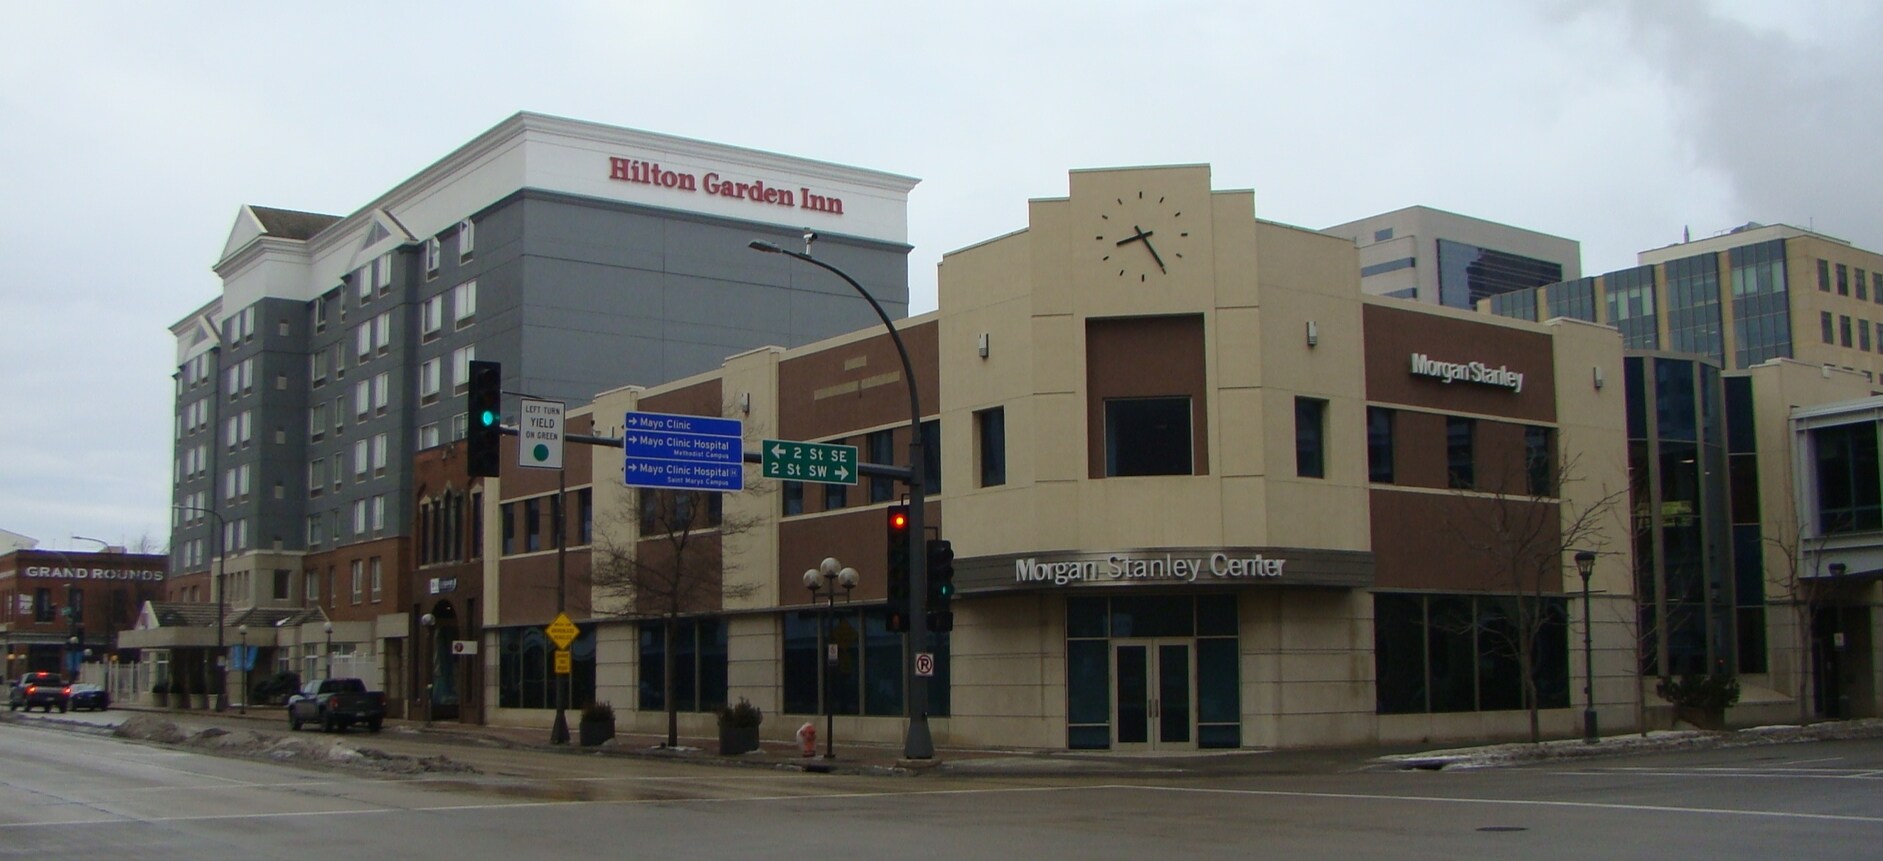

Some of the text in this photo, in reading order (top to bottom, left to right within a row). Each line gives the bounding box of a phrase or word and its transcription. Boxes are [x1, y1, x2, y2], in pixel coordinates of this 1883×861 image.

[609, 157, 844, 215] Hilton Garden Inn
[1411, 353, 1524, 393] Morgan Stanley
[525, 405, 560, 415] LEFT TURN
[530, 417, 555, 428] YIELD
[640, 417, 691, 430] Mayo Clinic
[525, 430, 558, 440] ON GREEN
[640, 436, 729, 452] Mayo Clinic Hospital
[673, 449, 729, 460] Methodist Campus
[793, 447, 847, 462] 2 St SE
[640, 463, 664, 476] Mayo
[666, 464, 691, 475] Clinic
[693, 466, 729, 479] Hospital
[771, 462, 827, 477] 2 St SW
[667, 476, 729, 487] Saint Marys Campus
[26, 566, 164, 581] GRAND ROUNDS
[1015, 553, 1286, 585] Morgan Stanley Center
